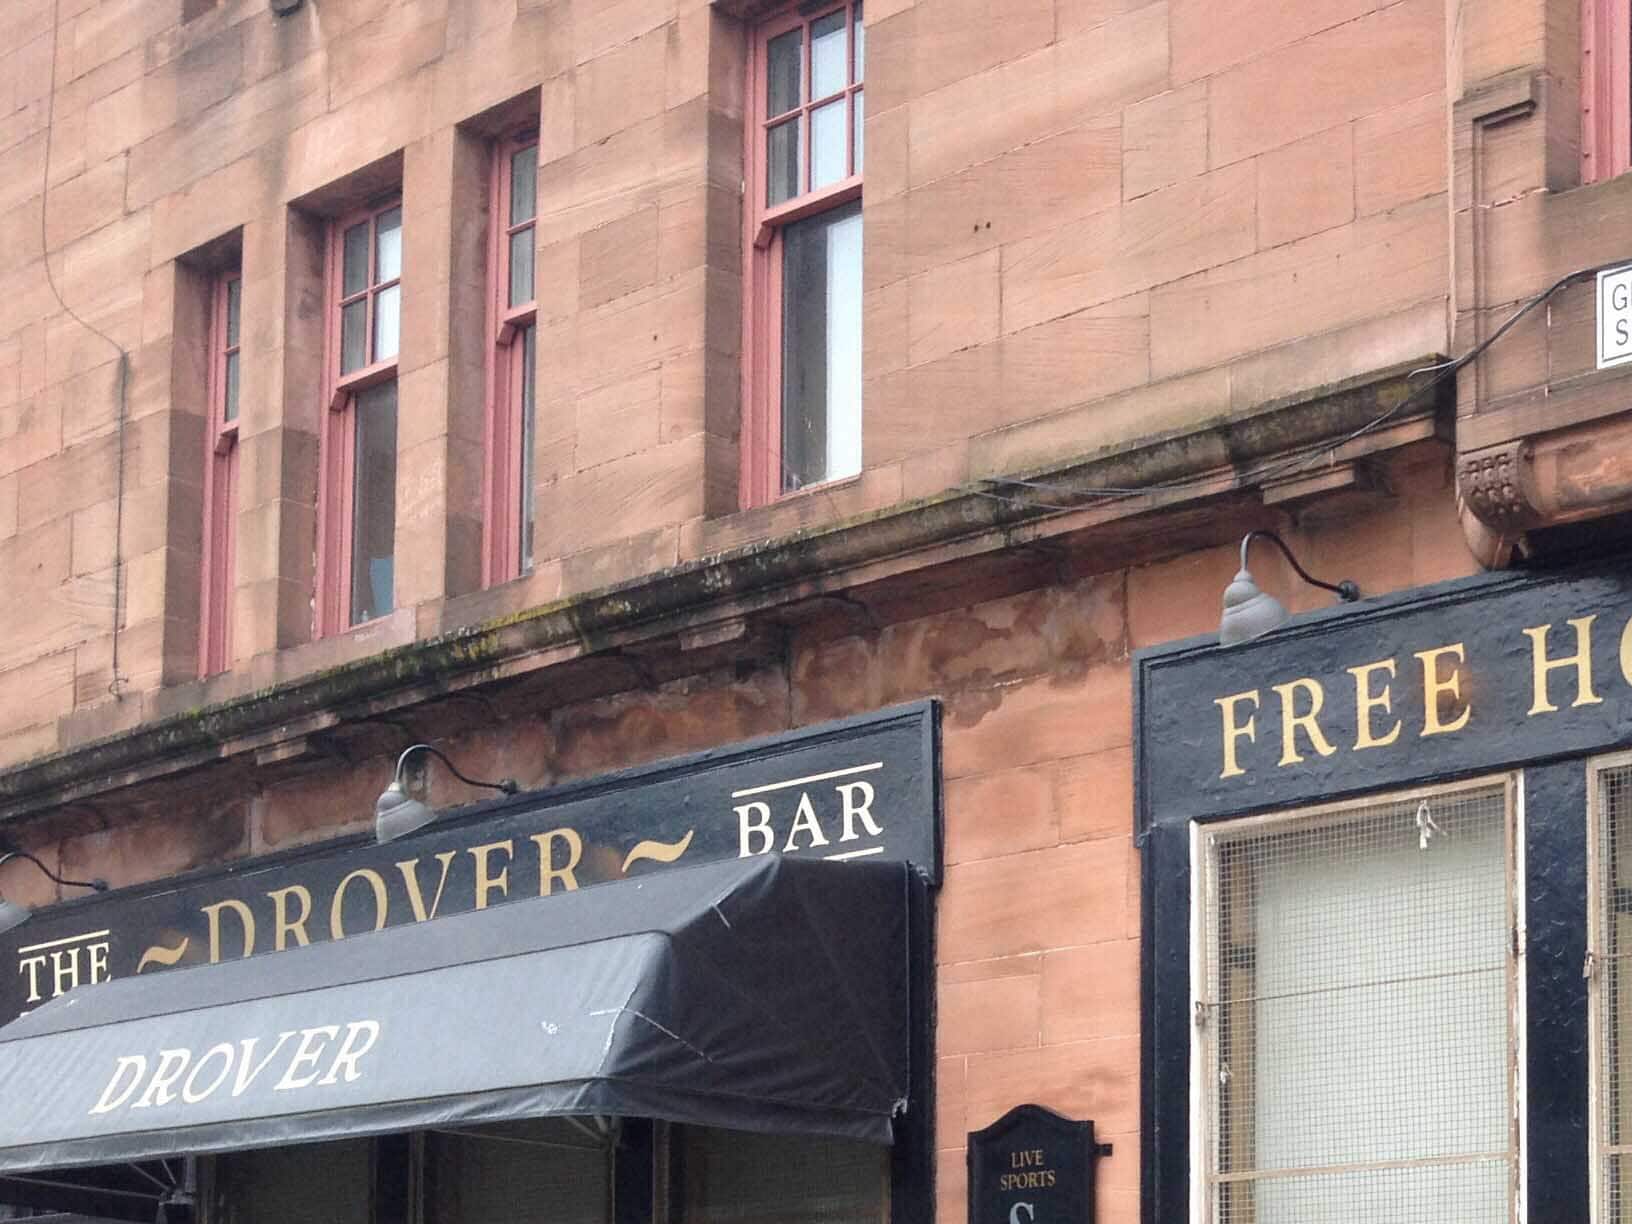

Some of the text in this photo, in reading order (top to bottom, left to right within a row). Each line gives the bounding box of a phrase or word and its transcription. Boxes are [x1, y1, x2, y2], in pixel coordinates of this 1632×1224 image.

[1213, 642, 1472, 779] FREE
[18, 779, 884, 1003] THE DROVER BAR
[87, 1018, 381, 1117] DROVER
[1000, 1169, 1056, 1192] SPORTS
[1010, 1148, 1045, 1169] LIVE
